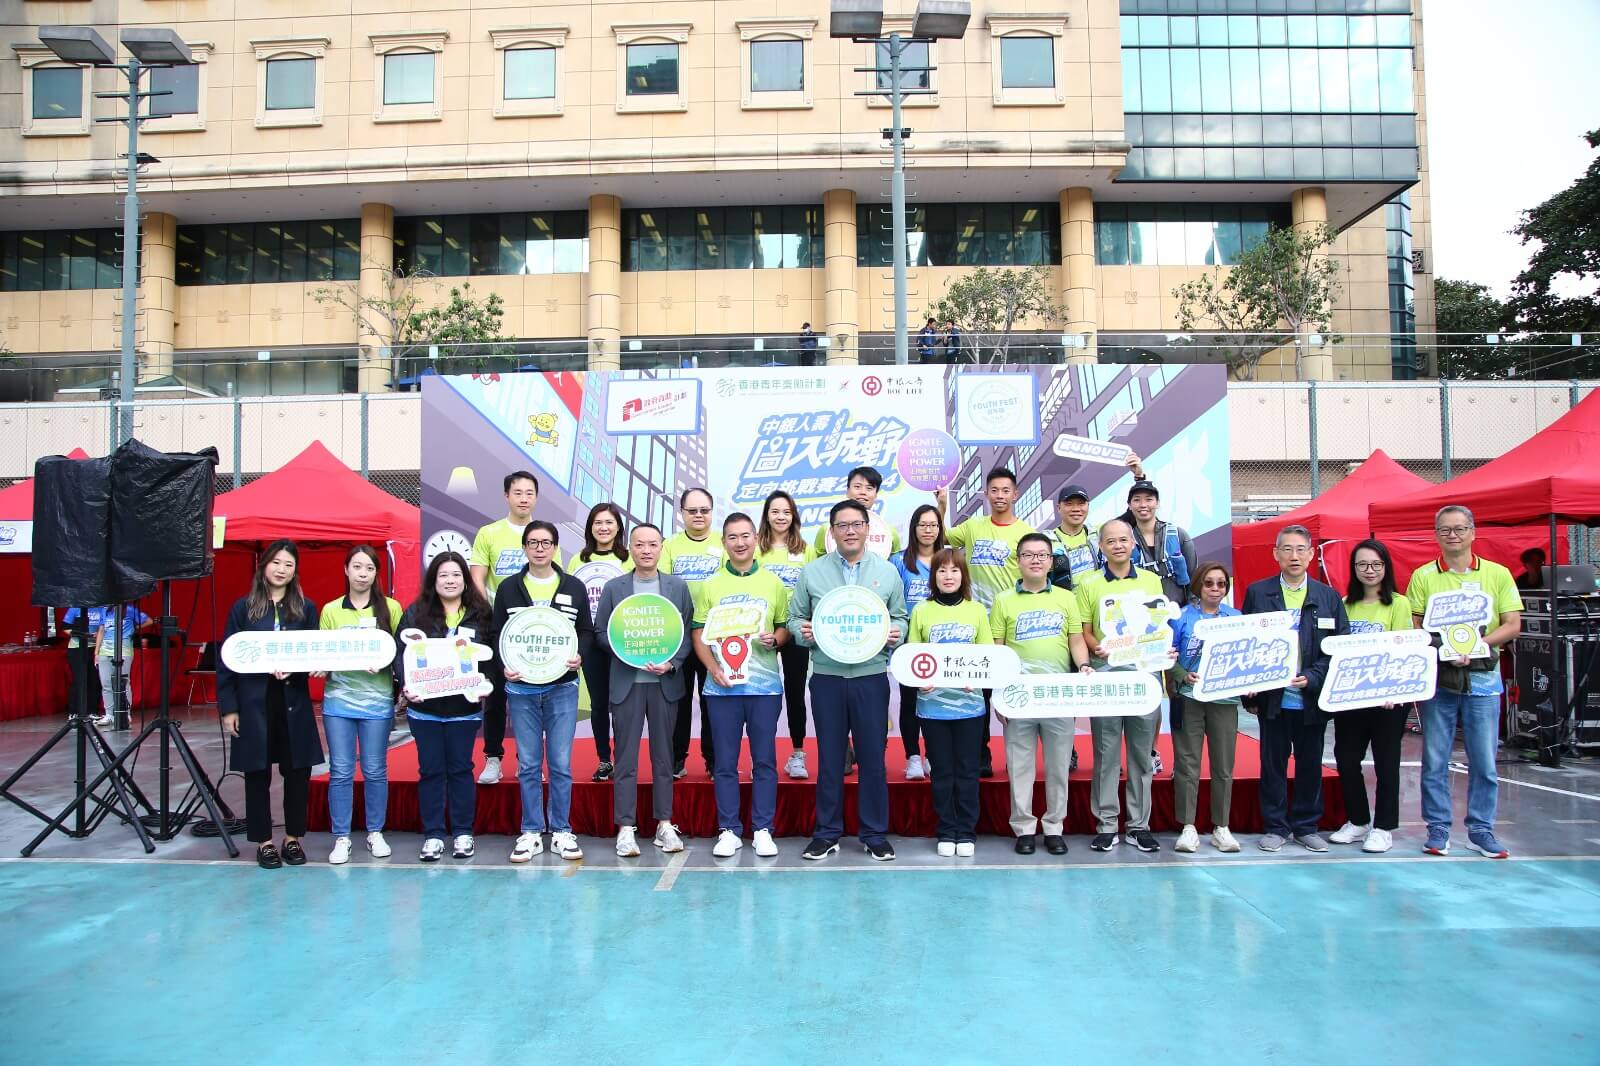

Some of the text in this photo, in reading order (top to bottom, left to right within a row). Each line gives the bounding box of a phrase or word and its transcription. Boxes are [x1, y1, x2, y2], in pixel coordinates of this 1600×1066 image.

[973, 397, 1018, 410] YOUTH FEST
[763, 414, 833, 434] 中銀人壽
[909, 438, 943, 446] IGNITE
[909, 448, 945, 456] YOUTH
[909, 458, 945, 466] POWER
[865, 534, 886, 543] FEST
[622, 605, 661, 616] IGNITE
[624, 616, 665, 627] YOUTH
[820, 614, 883, 625] YOUTH FEST
[623, 627, 665, 639] POWER
[508, 634, 571, 646] YOUTH FEST
[943, 670, 991, 679] BOC LIFE
[1032, 682, 1147, 699] 香港青年獎勵計劃
